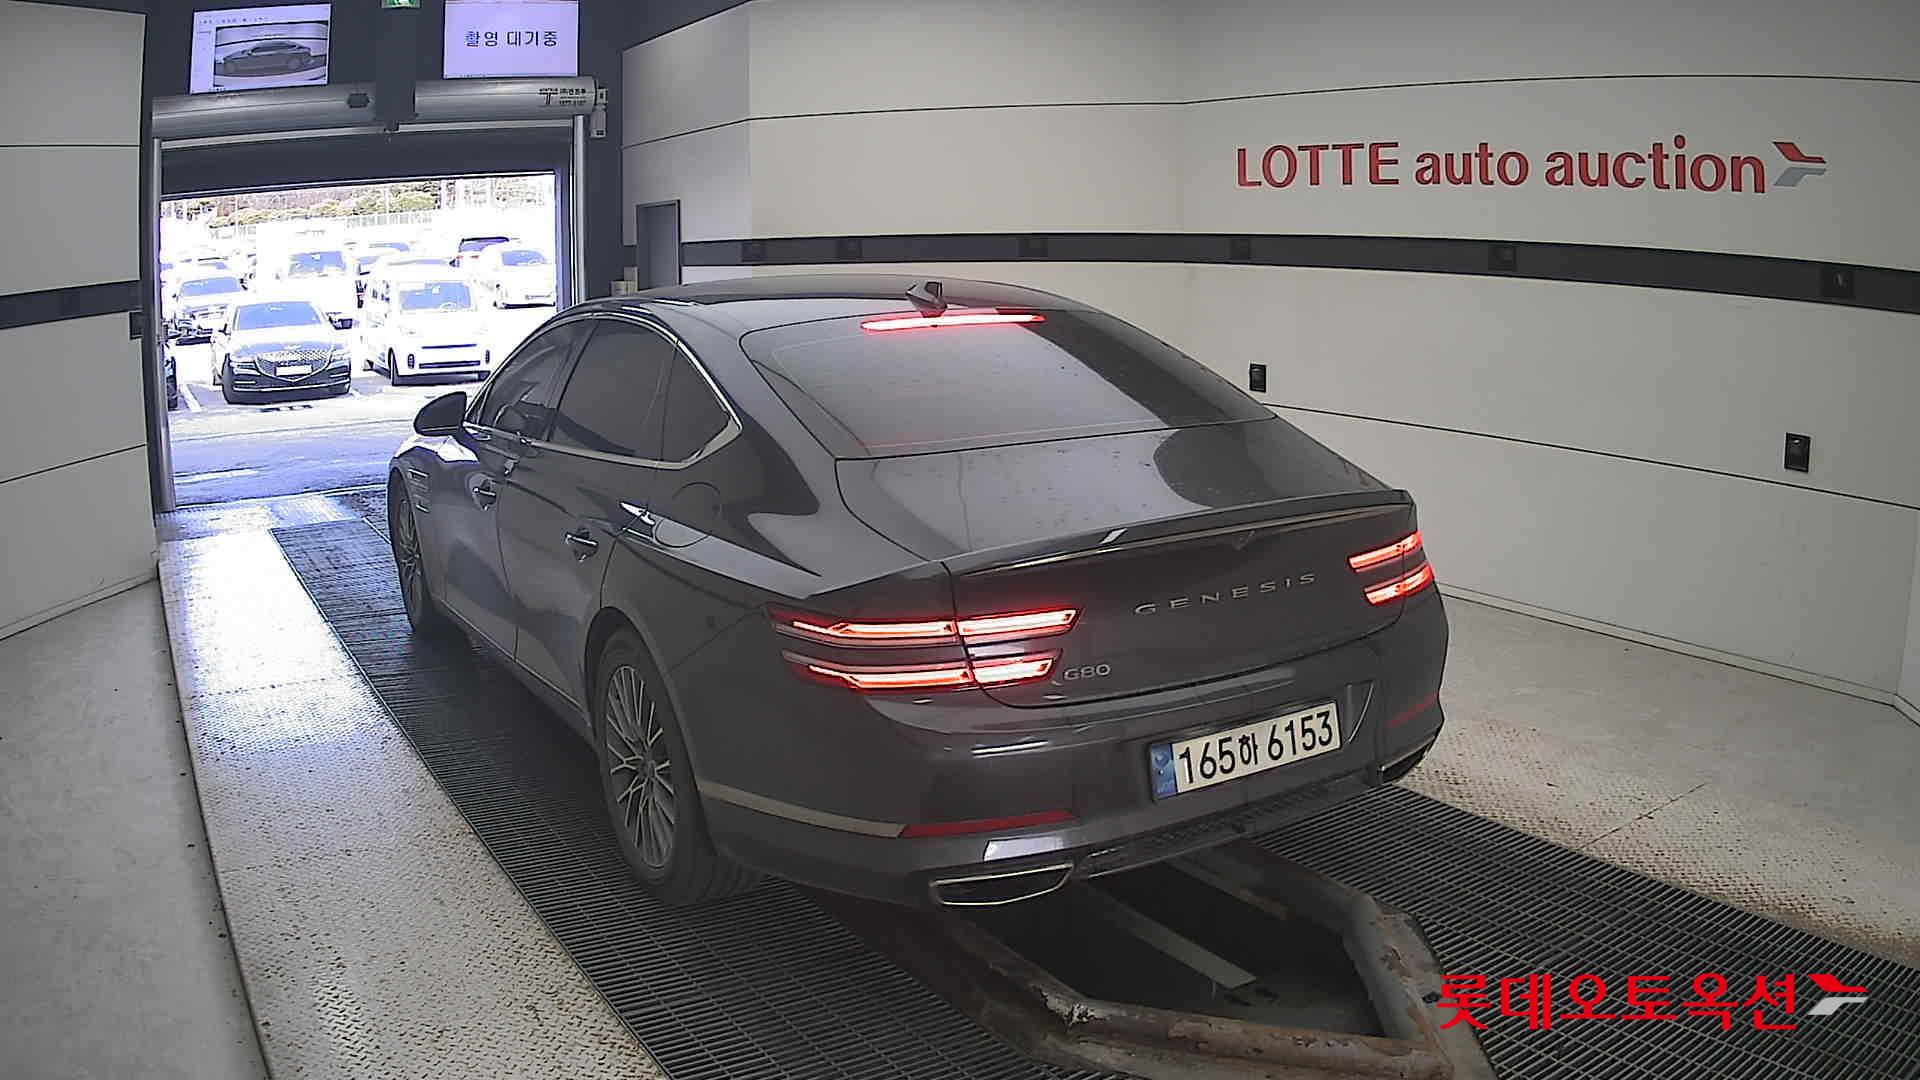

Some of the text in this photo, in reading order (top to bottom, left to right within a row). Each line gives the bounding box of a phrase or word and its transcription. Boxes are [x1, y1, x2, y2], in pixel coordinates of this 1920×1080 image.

[464, 31, 558, 48] 촬영 대기중
[1237, 134, 1767, 194] LOTTE auto auction
[1134, 572, 1316, 616] GENESIS
[1063, 663, 1112, 682] G80
[1178, 710, 1333, 785] 165하 6153
